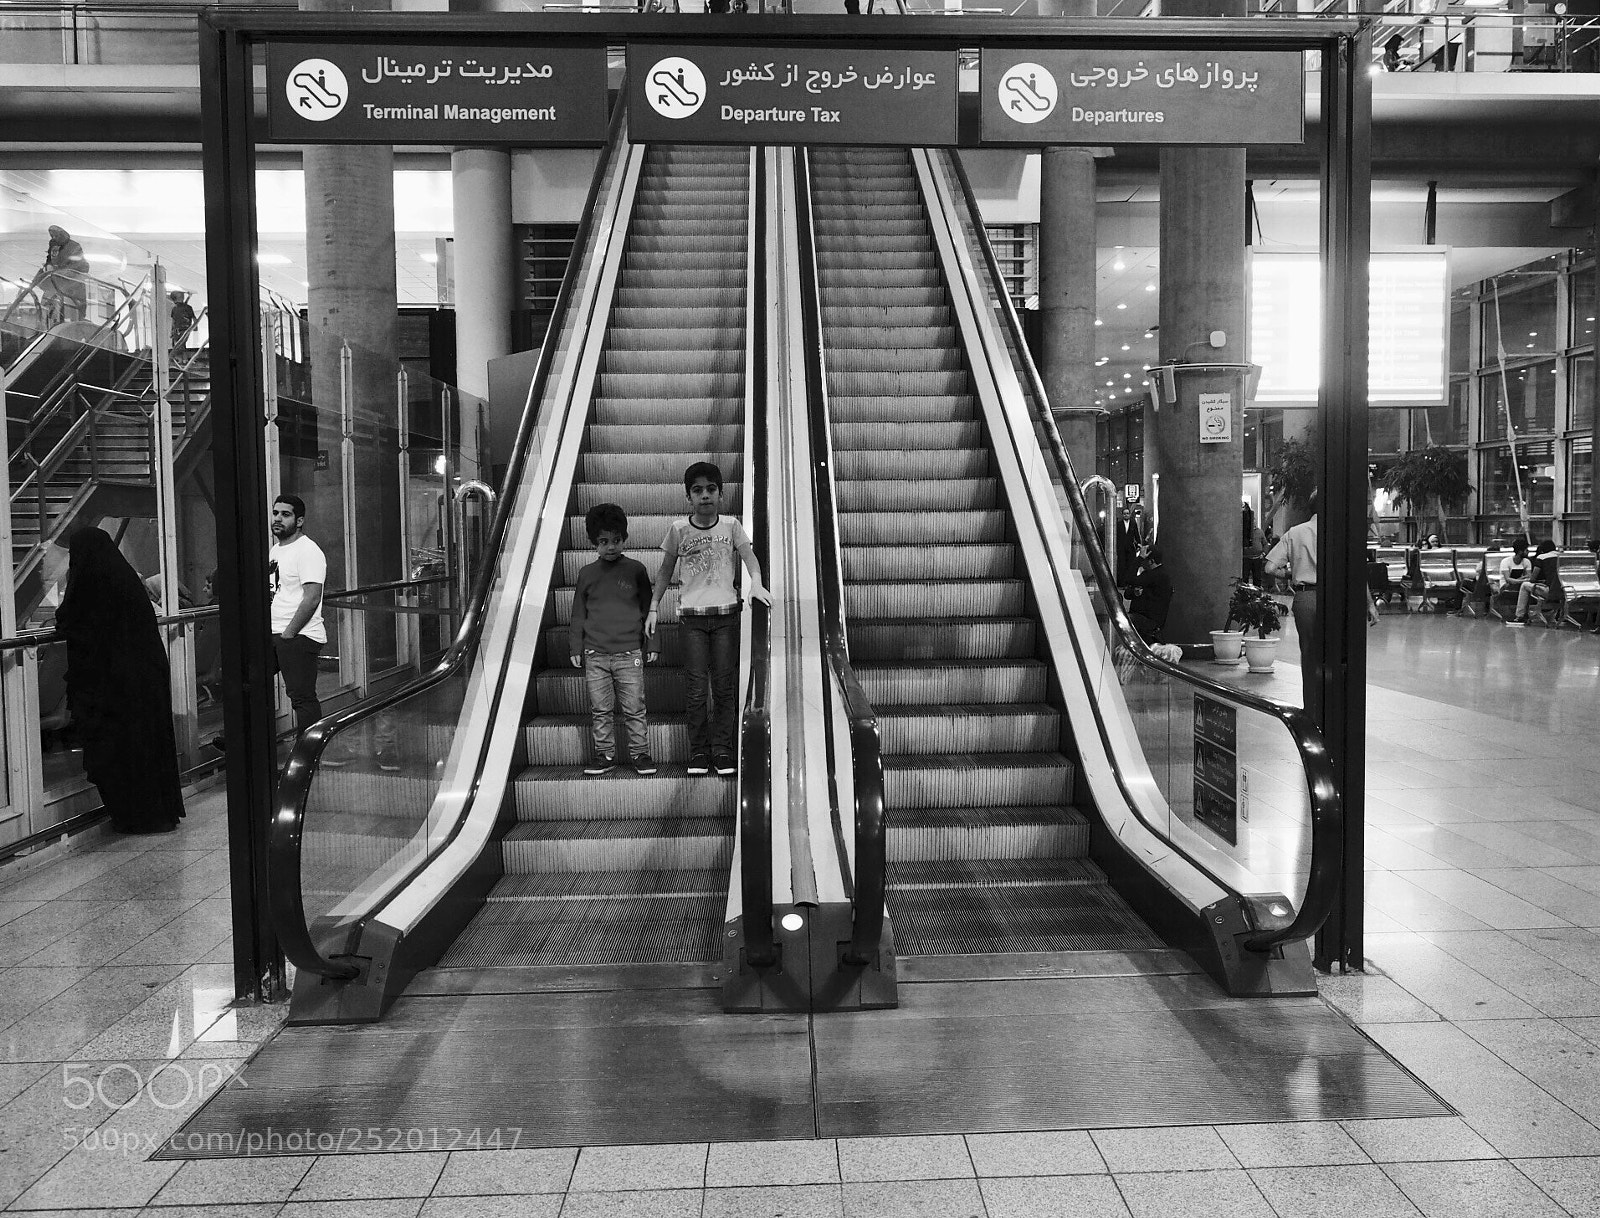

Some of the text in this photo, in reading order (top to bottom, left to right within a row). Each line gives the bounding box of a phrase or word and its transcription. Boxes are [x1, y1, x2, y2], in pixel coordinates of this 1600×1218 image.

[361, 56, 553, 85] مدیریت ترمینال
[719, 62, 936, 94] عوارض خروج از کشور
[1070, 61, 1149, 88] خروجی
[363, 104, 556, 123] Terminal Management
[721, 105, 840, 124] Departure Tax
[1072, 107, 1164, 125] Departures
